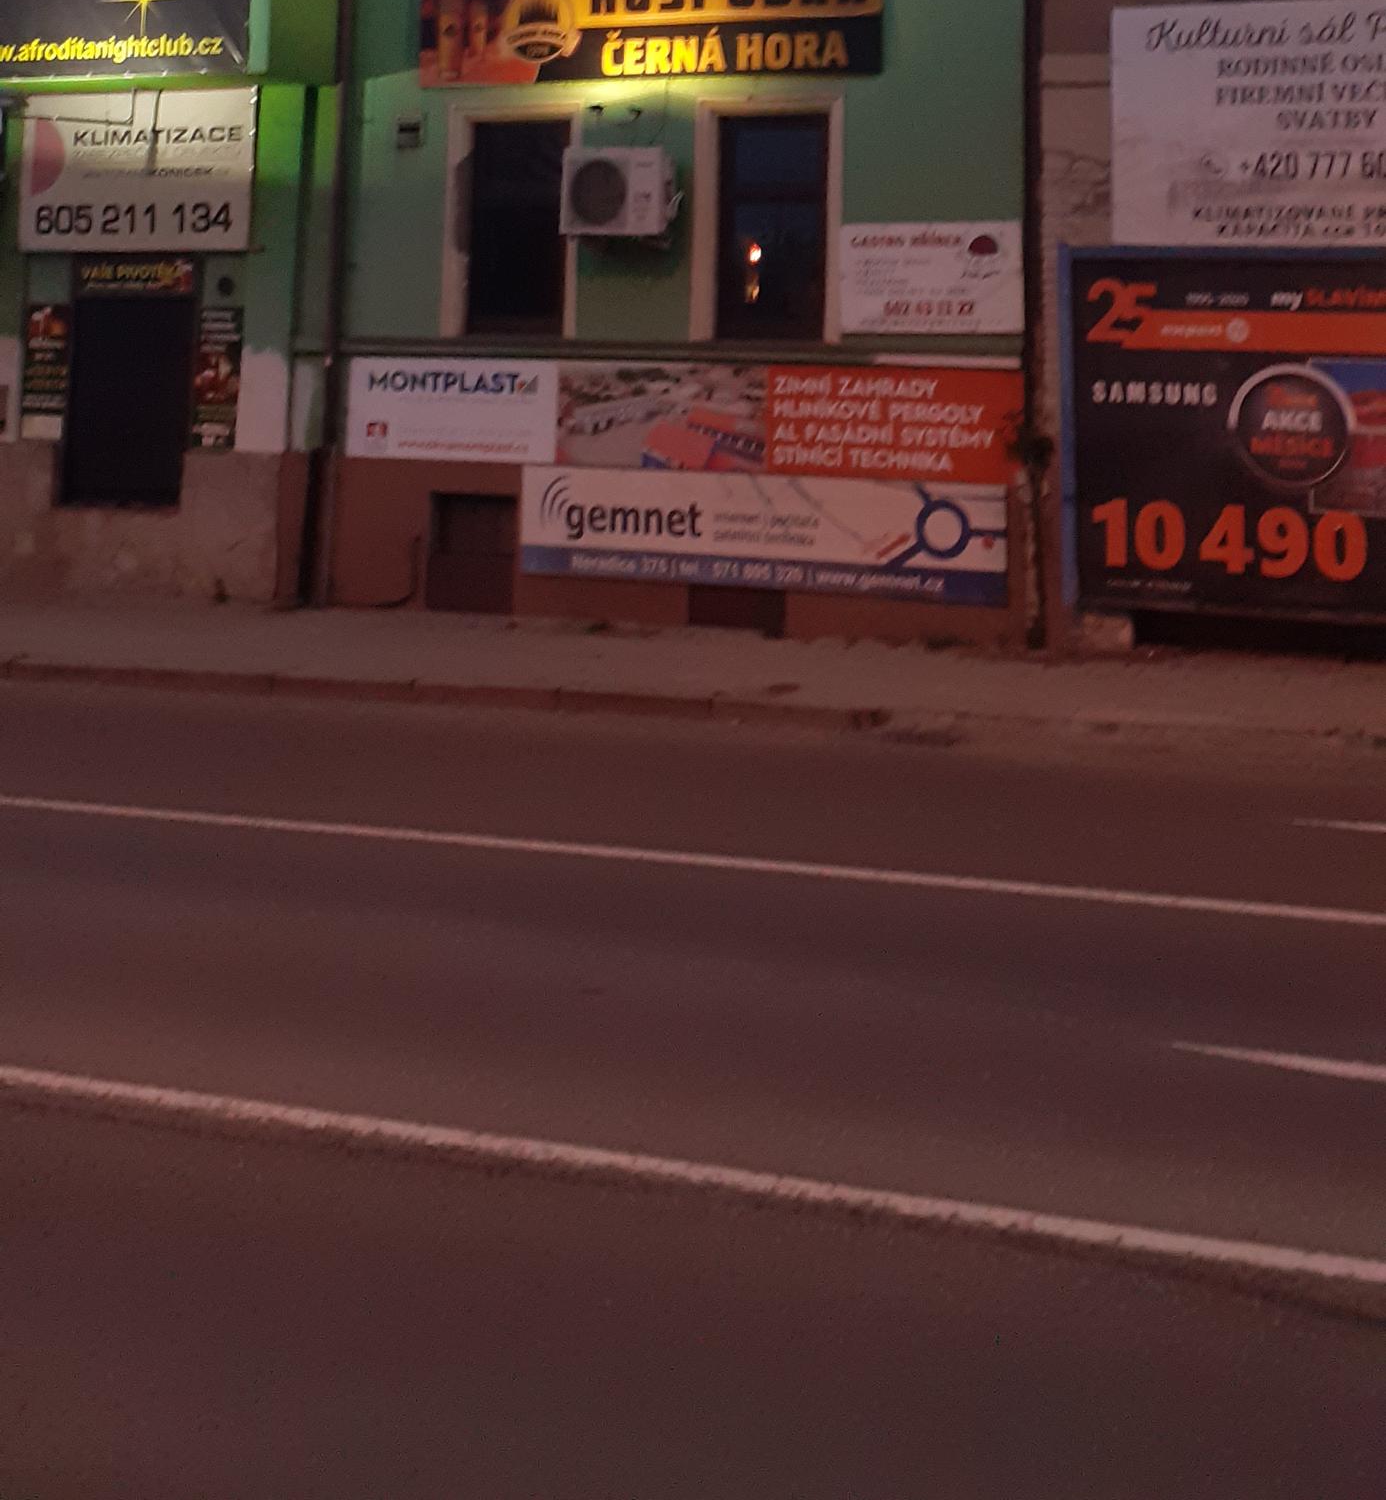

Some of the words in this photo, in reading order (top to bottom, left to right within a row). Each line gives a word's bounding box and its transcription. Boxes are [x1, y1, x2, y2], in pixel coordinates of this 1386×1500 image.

[1147, 16, 1291, 51] Kulturní
[1301, 11, 1356, 45] sál
[601, 26, 728, 77] ČERNÁ
[736, 30, 850, 72] HORA
[1276, 109, 1377, 131] SVATBY
[73, 126, 243, 148] KLIMATIZACE
[1307, 152, 1352, 180] 777
[35, 204, 95, 236] 605
[101, 203, 157, 235] 211
[173, 202, 234, 234] 134
[367, 370, 520, 395] MONTPLAST
[774, 373, 832, 395] ZIMNÍ
[838, 377, 940, 398] ZAHRADY
[1092, 380, 1217, 406] SAMSUNG
[888, 403, 985, 425] PERGOLY
[1261, 409, 1323, 433] AKCE
[773, 424, 798, 442] AL
[900, 425, 995, 449] SYSTÉMY
[849, 451, 954, 472] TECHNIKA
[565, 500, 702, 539] gemnet
[1092, 498, 1186, 570] 10
[1198, 504, 1368, 582] 490
